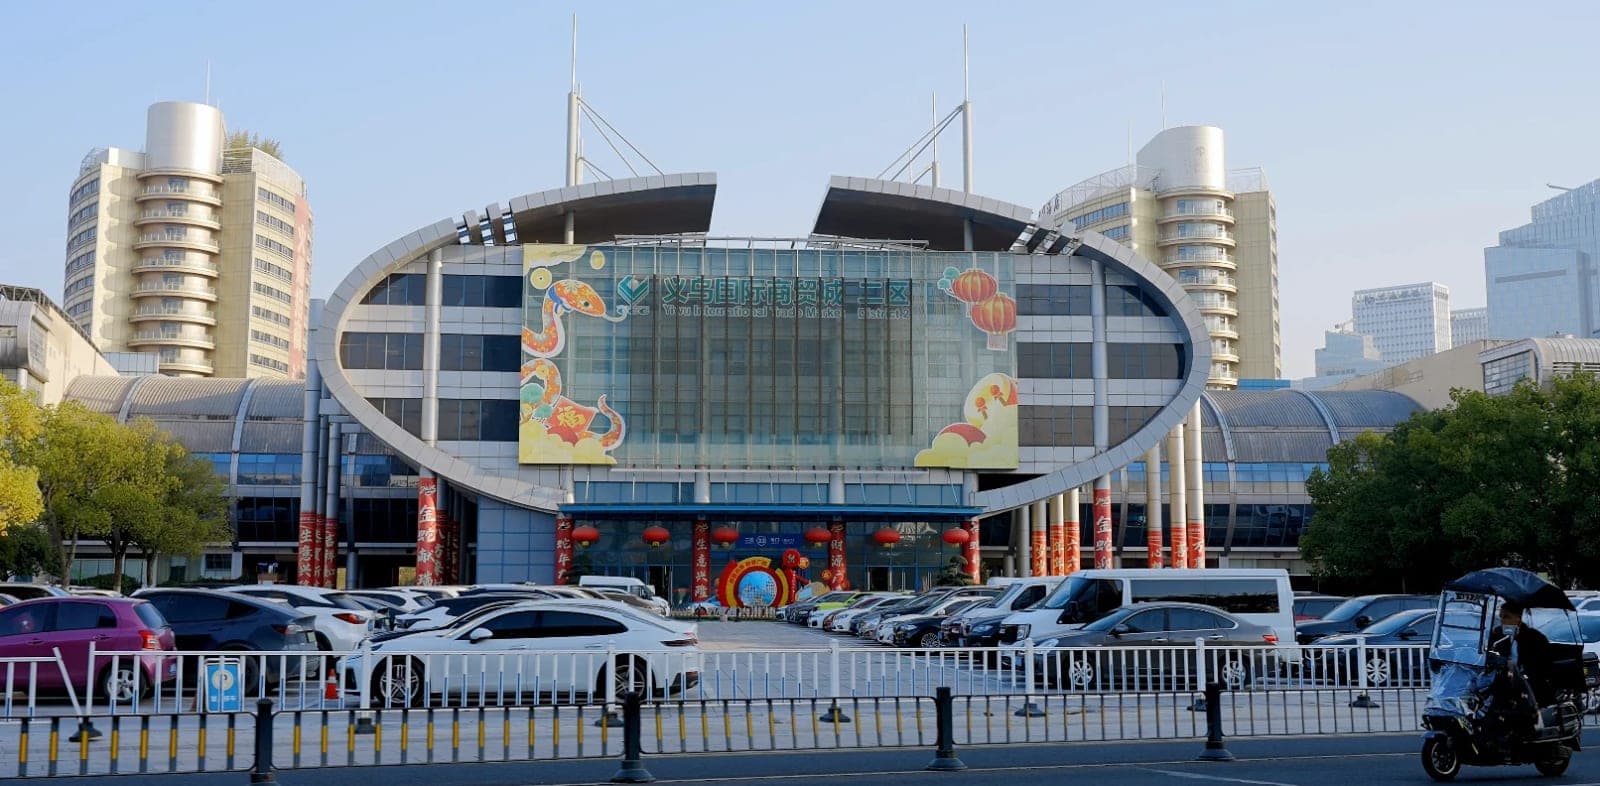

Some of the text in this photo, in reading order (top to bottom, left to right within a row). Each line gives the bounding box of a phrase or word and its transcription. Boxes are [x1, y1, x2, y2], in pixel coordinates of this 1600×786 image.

[663, 277, 909, 306] 义乌国际商贸城 二区
[557, 405, 586, 428] 福
[694, 538, 709, 598] 生意兴隆
